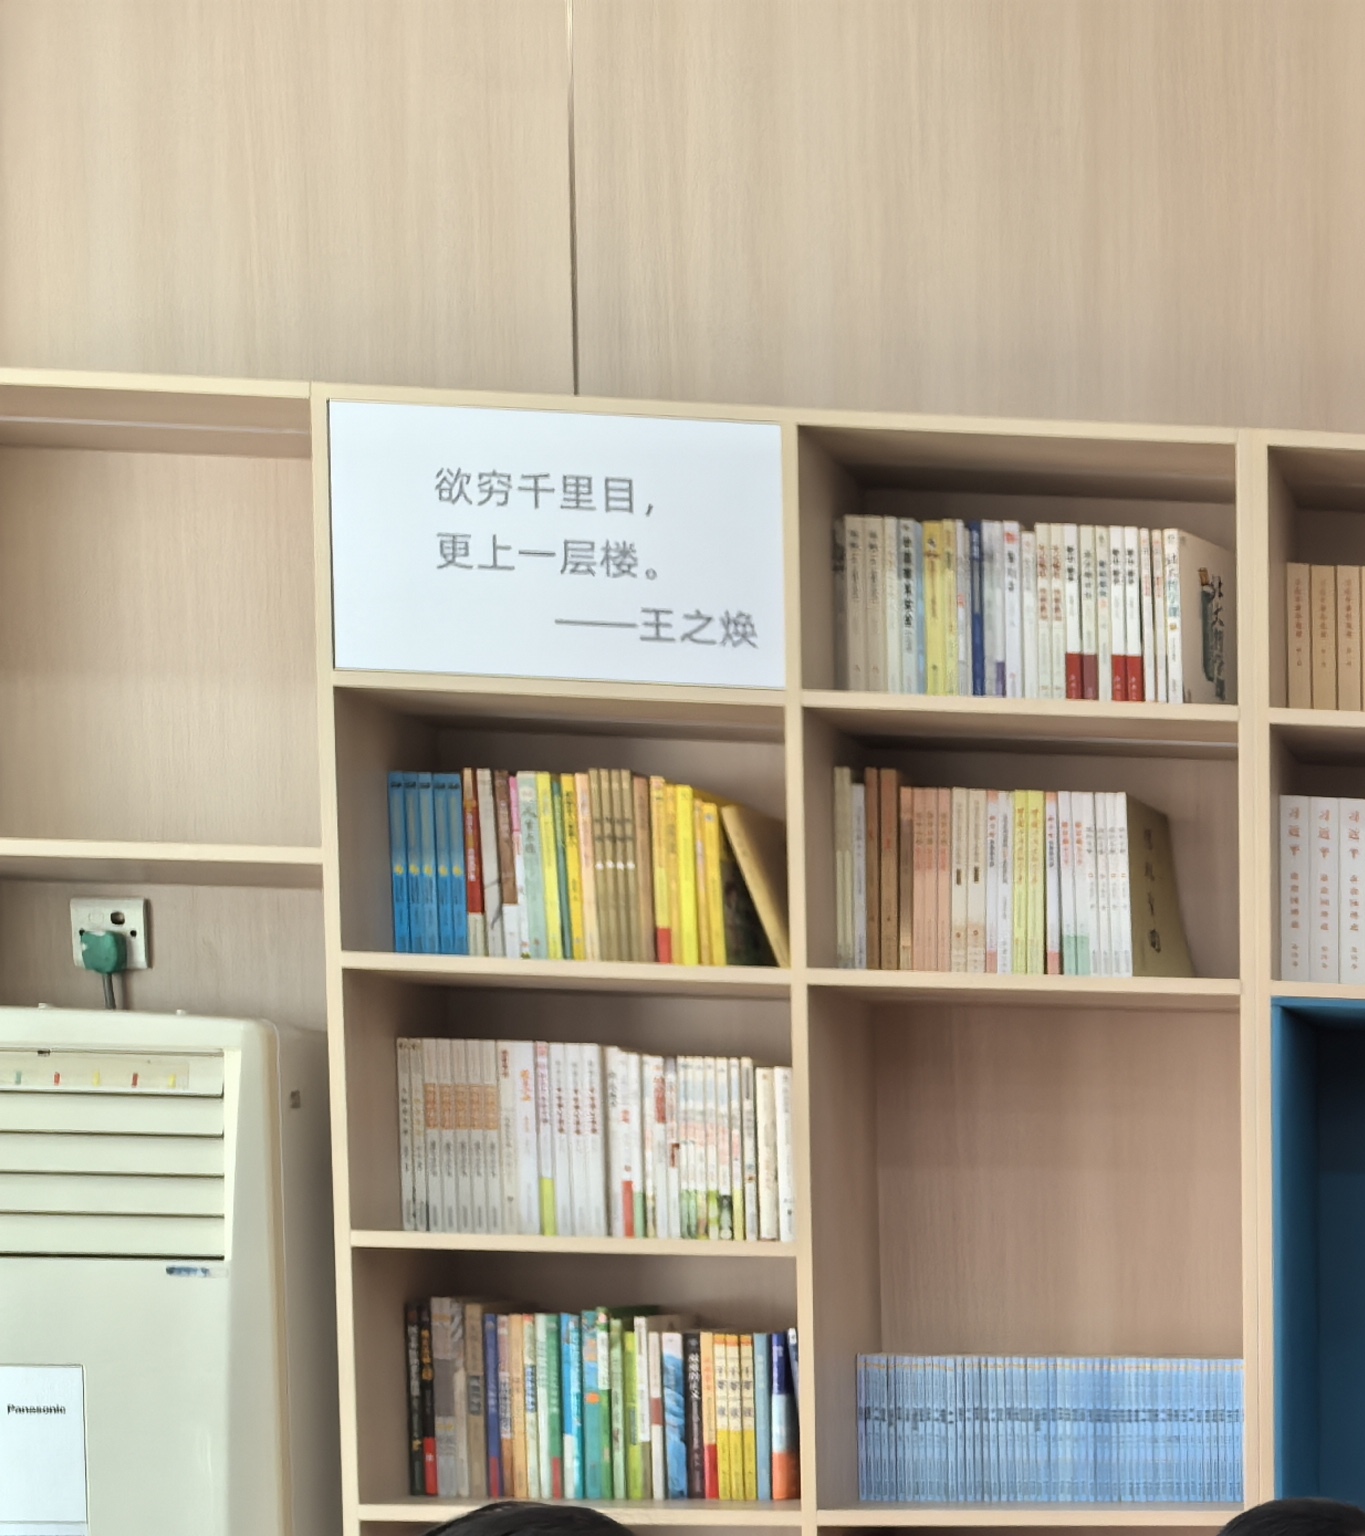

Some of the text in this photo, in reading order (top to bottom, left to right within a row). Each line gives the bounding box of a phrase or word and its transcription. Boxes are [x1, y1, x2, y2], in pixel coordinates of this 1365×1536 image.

[435, 467, 653, 517] 欲穷千里目，
[436, 532, 657, 580] 更上一层楼。
[7, 1404, 66, 1414] Panasonic
